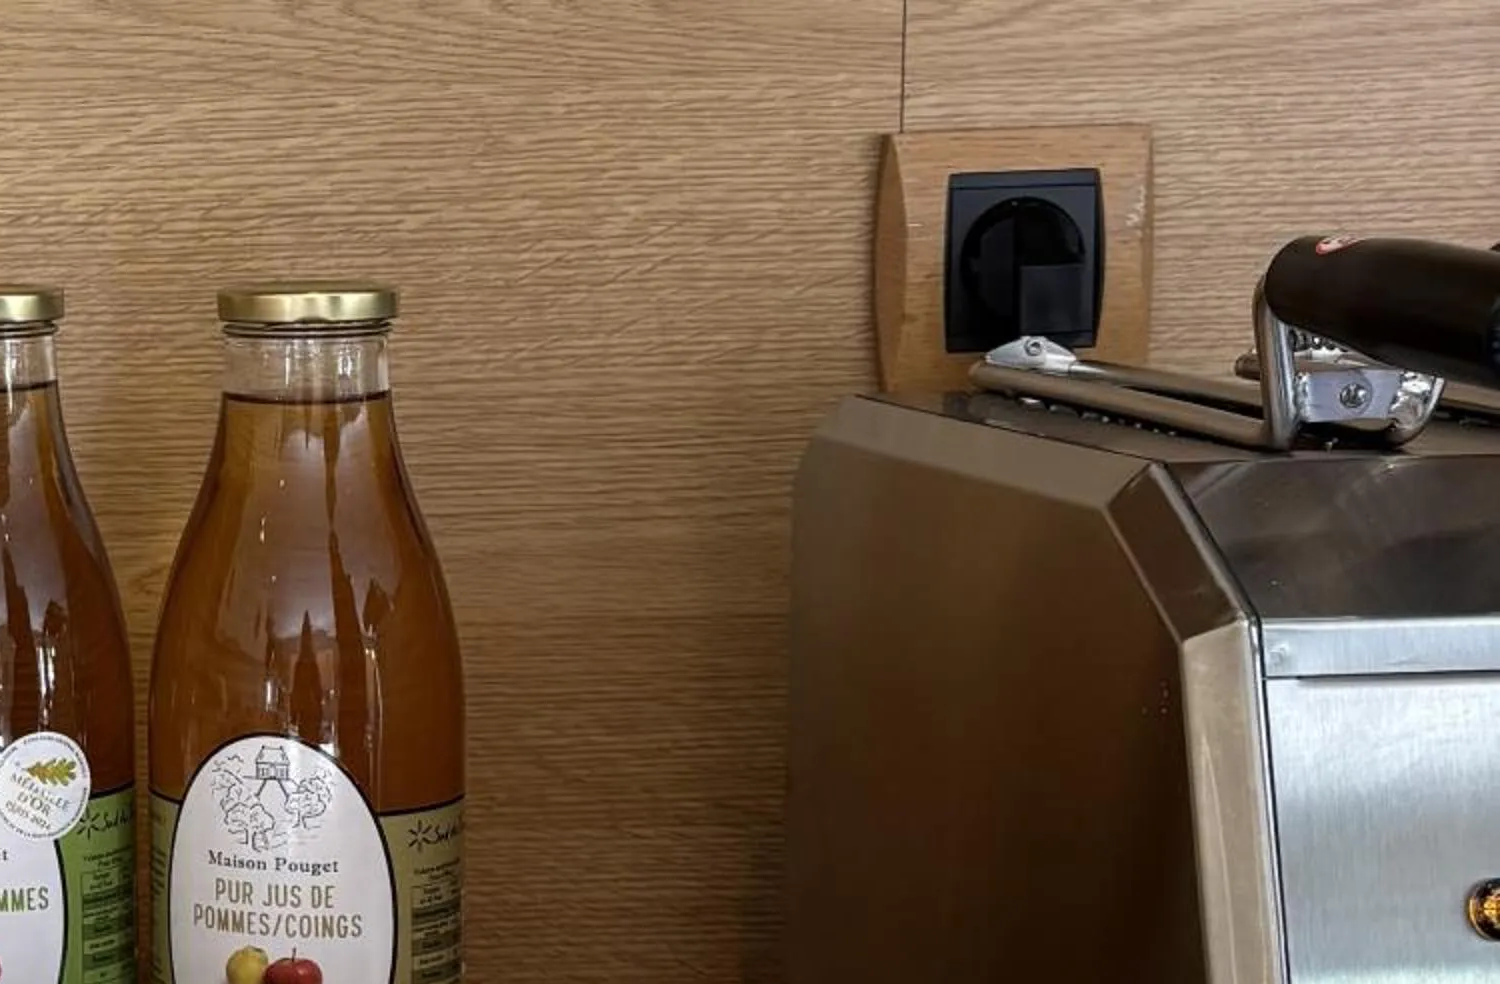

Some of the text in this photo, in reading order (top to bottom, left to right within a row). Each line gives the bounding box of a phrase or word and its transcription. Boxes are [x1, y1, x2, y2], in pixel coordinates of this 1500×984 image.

[208, 849, 339, 877] Maison Pouget
[216, 878, 336, 909] PUR JUS DE
[193, 903, 363, 938] POMMES/COINGS
